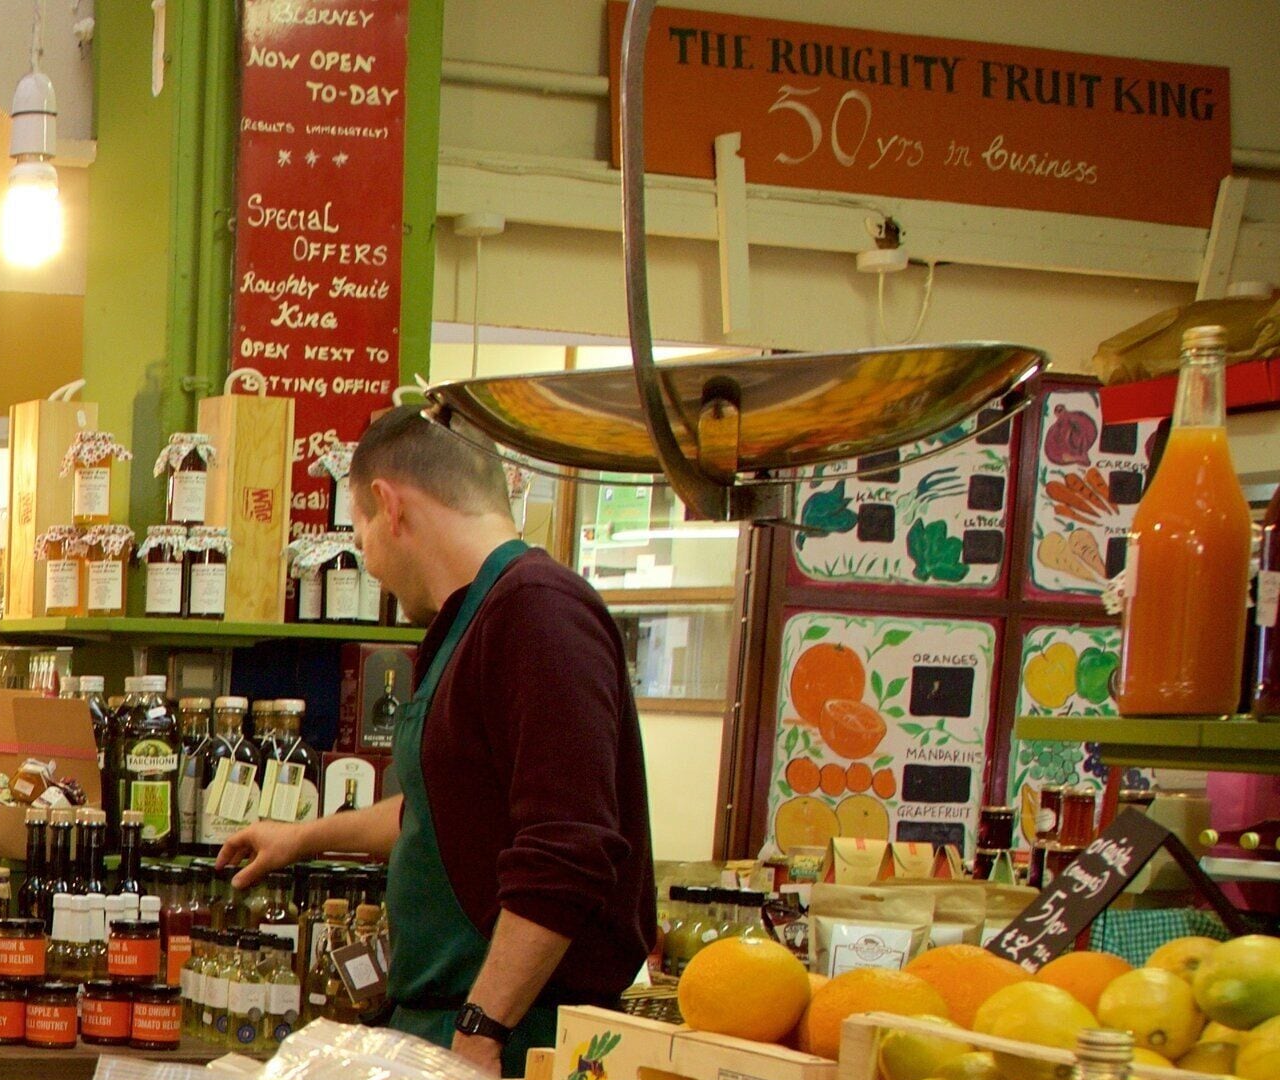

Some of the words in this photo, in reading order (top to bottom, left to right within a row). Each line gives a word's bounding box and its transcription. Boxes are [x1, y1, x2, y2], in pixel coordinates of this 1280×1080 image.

[246, 47, 300, 69] NOW
[310, 50, 376, 73] OPEN
[669, 27, 754, 69] THE
[766, 36, 964, 94] ROUGHTY
[978, 60, 1101, 109] FRUIT
[1114, 76, 1215, 121] KING
[768, 85, 872, 168] 50
[945, 139, 971, 167] in
[240, 338, 289, 360] OPEN
[304, 345, 355, 363] NEXT
[366, 347, 389, 364] TO
[332, 376, 390, 395] OFFICE
[913, 653, 978, 666] ORANGES
[906, 748, 983, 764] MANDARINS
[897, 805, 971, 819] GRAPEFRUIT
